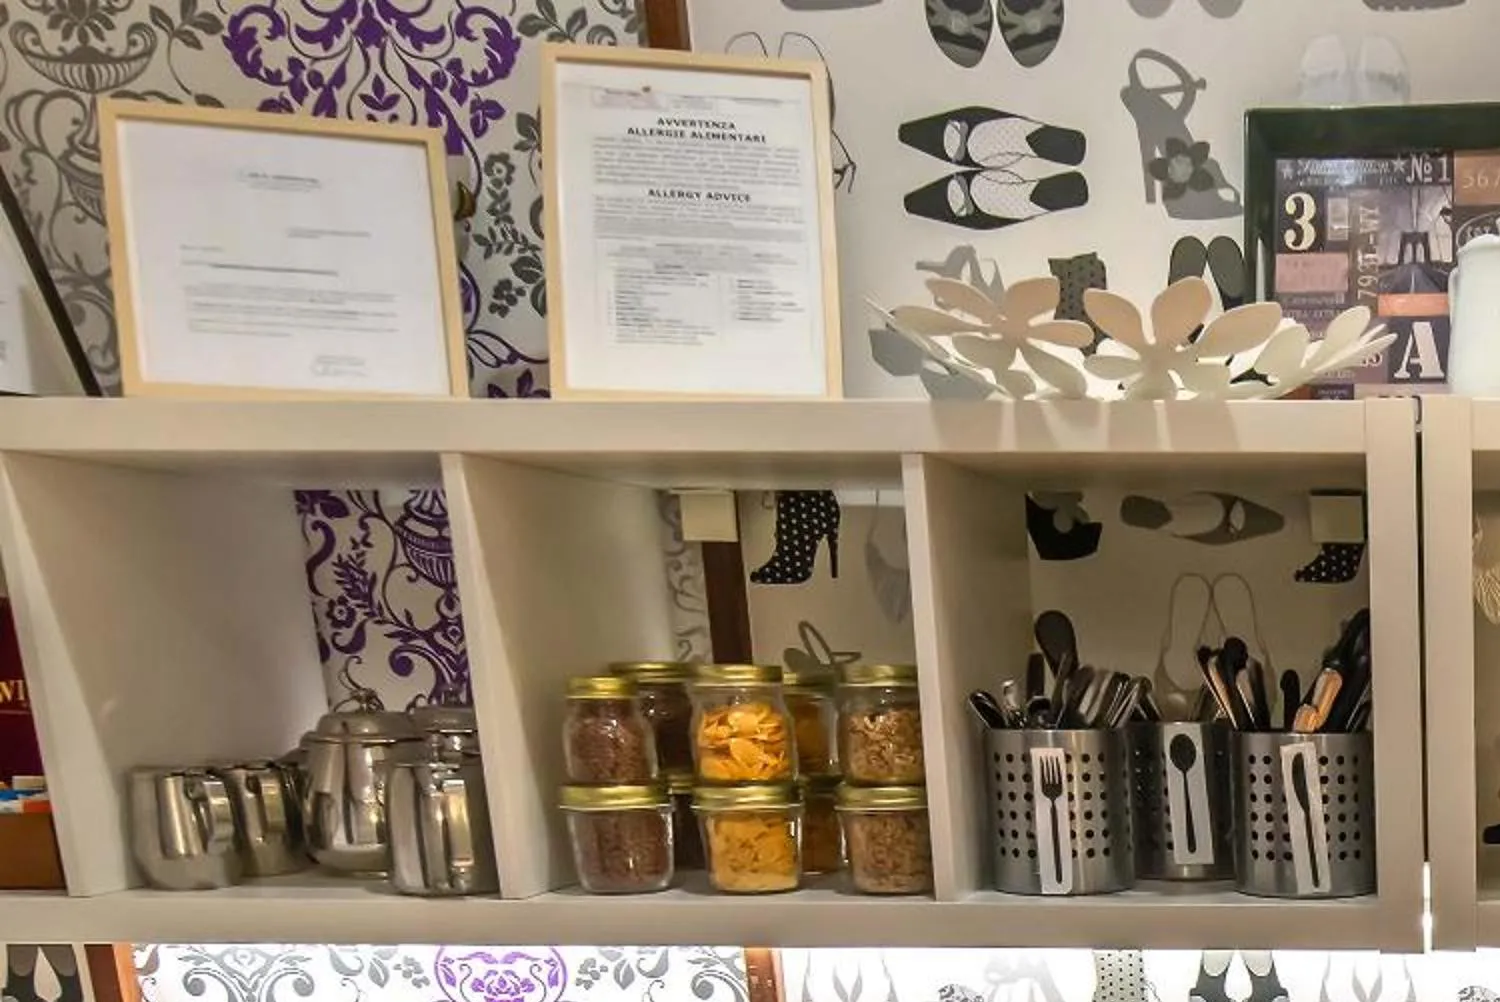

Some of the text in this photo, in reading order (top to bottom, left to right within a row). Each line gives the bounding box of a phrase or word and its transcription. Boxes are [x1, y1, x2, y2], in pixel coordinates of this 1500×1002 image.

[657, 117, 736, 130] AVVERTENZA
[627, 126, 767, 144] ALLERGIE ALIMENTARI
[648, 188, 751, 203] ALLERGY ADVICE
[1284, 192, 1316, 250] 3
[1394, 321, 1445, 379] A
